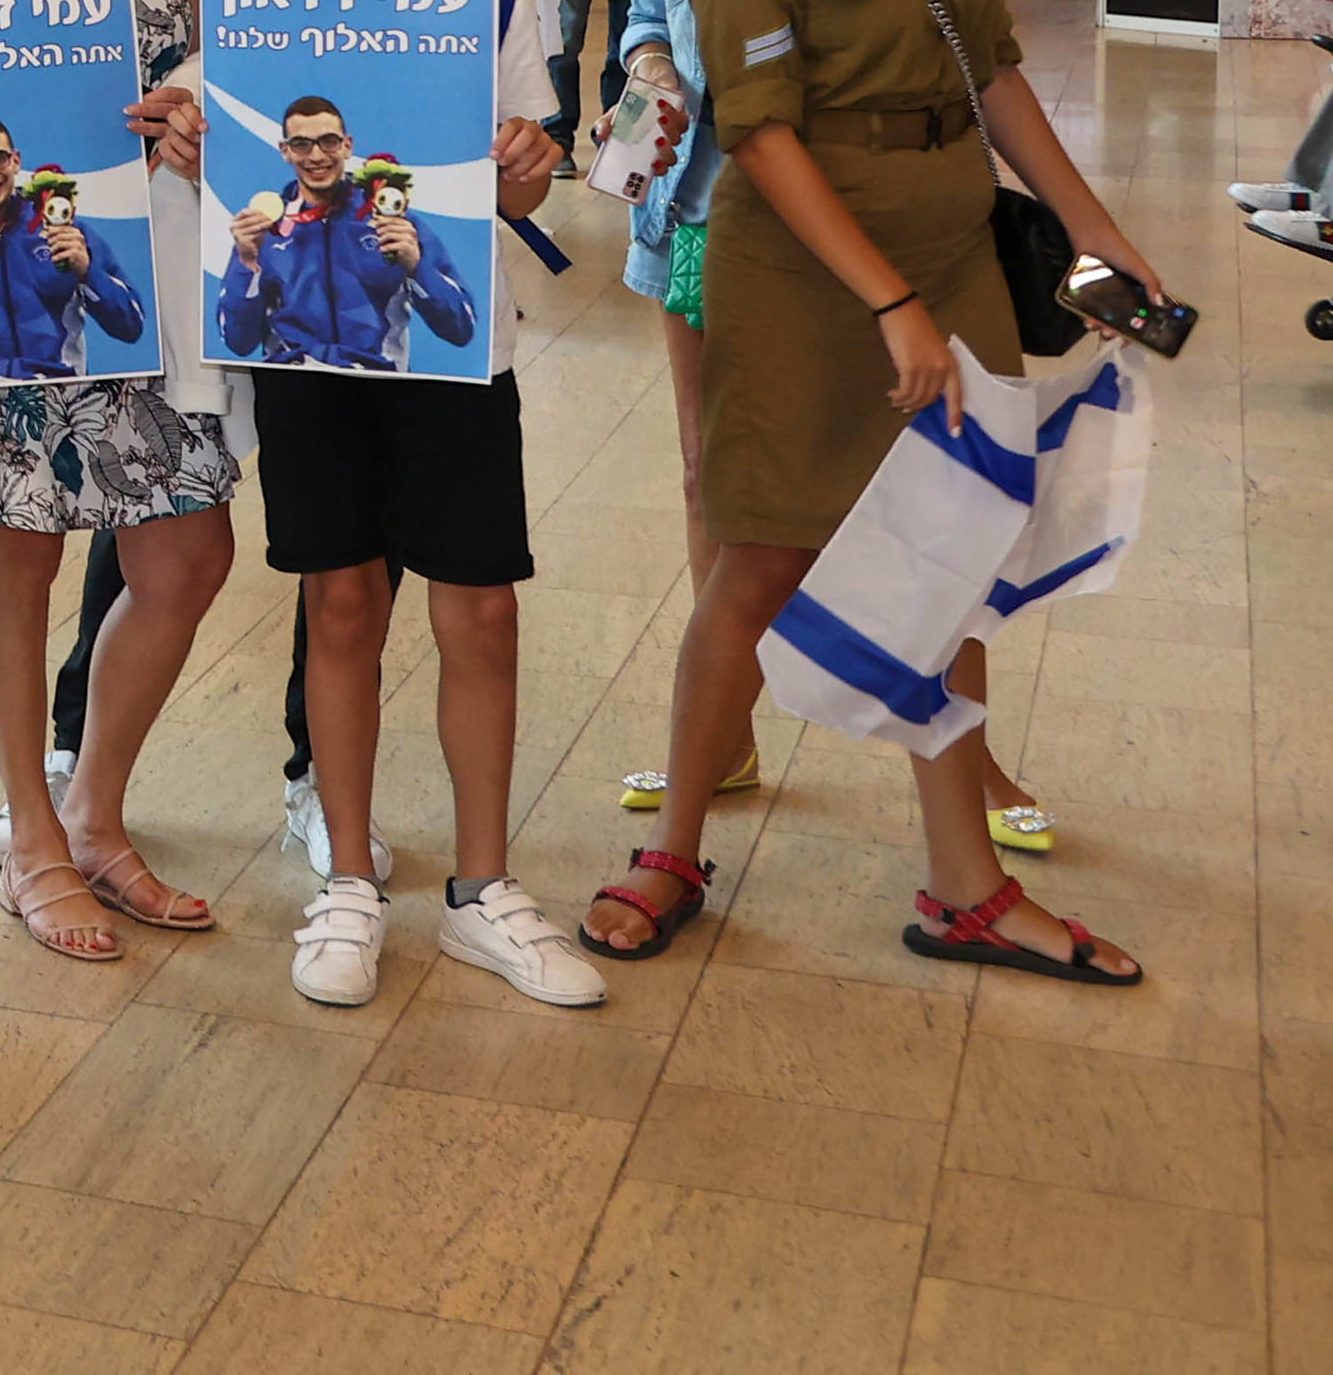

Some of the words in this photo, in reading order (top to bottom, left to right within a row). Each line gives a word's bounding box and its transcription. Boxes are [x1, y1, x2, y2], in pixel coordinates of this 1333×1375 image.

[216, 25, 290, 50] שלנו!
[301, 26, 409, 57] האלוף
[418, 34, 479, 54] אתה
[71, 43, 124, 66] אתה
